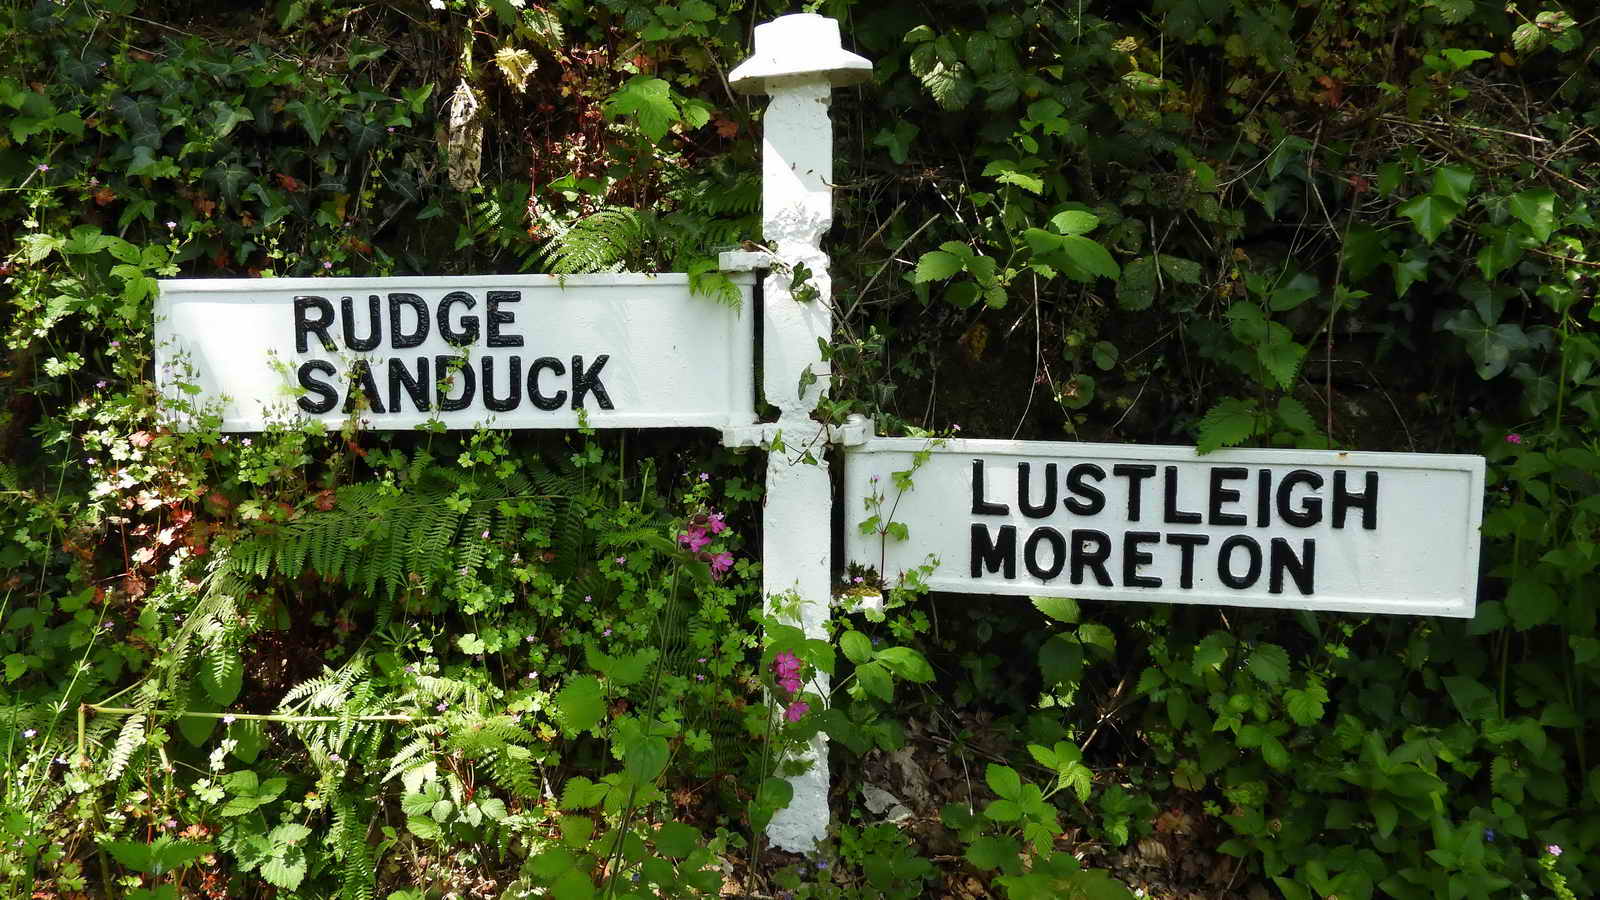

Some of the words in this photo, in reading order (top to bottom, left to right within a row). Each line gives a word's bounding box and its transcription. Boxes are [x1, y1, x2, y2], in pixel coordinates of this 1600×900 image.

[294, 290, 524, 353] RUDGE
[297, 354, 615, 414] SANDUCK
[971, 458, 1378, 530] LUSTLEIGH
[971, 523, 1316, 595] MORETON
